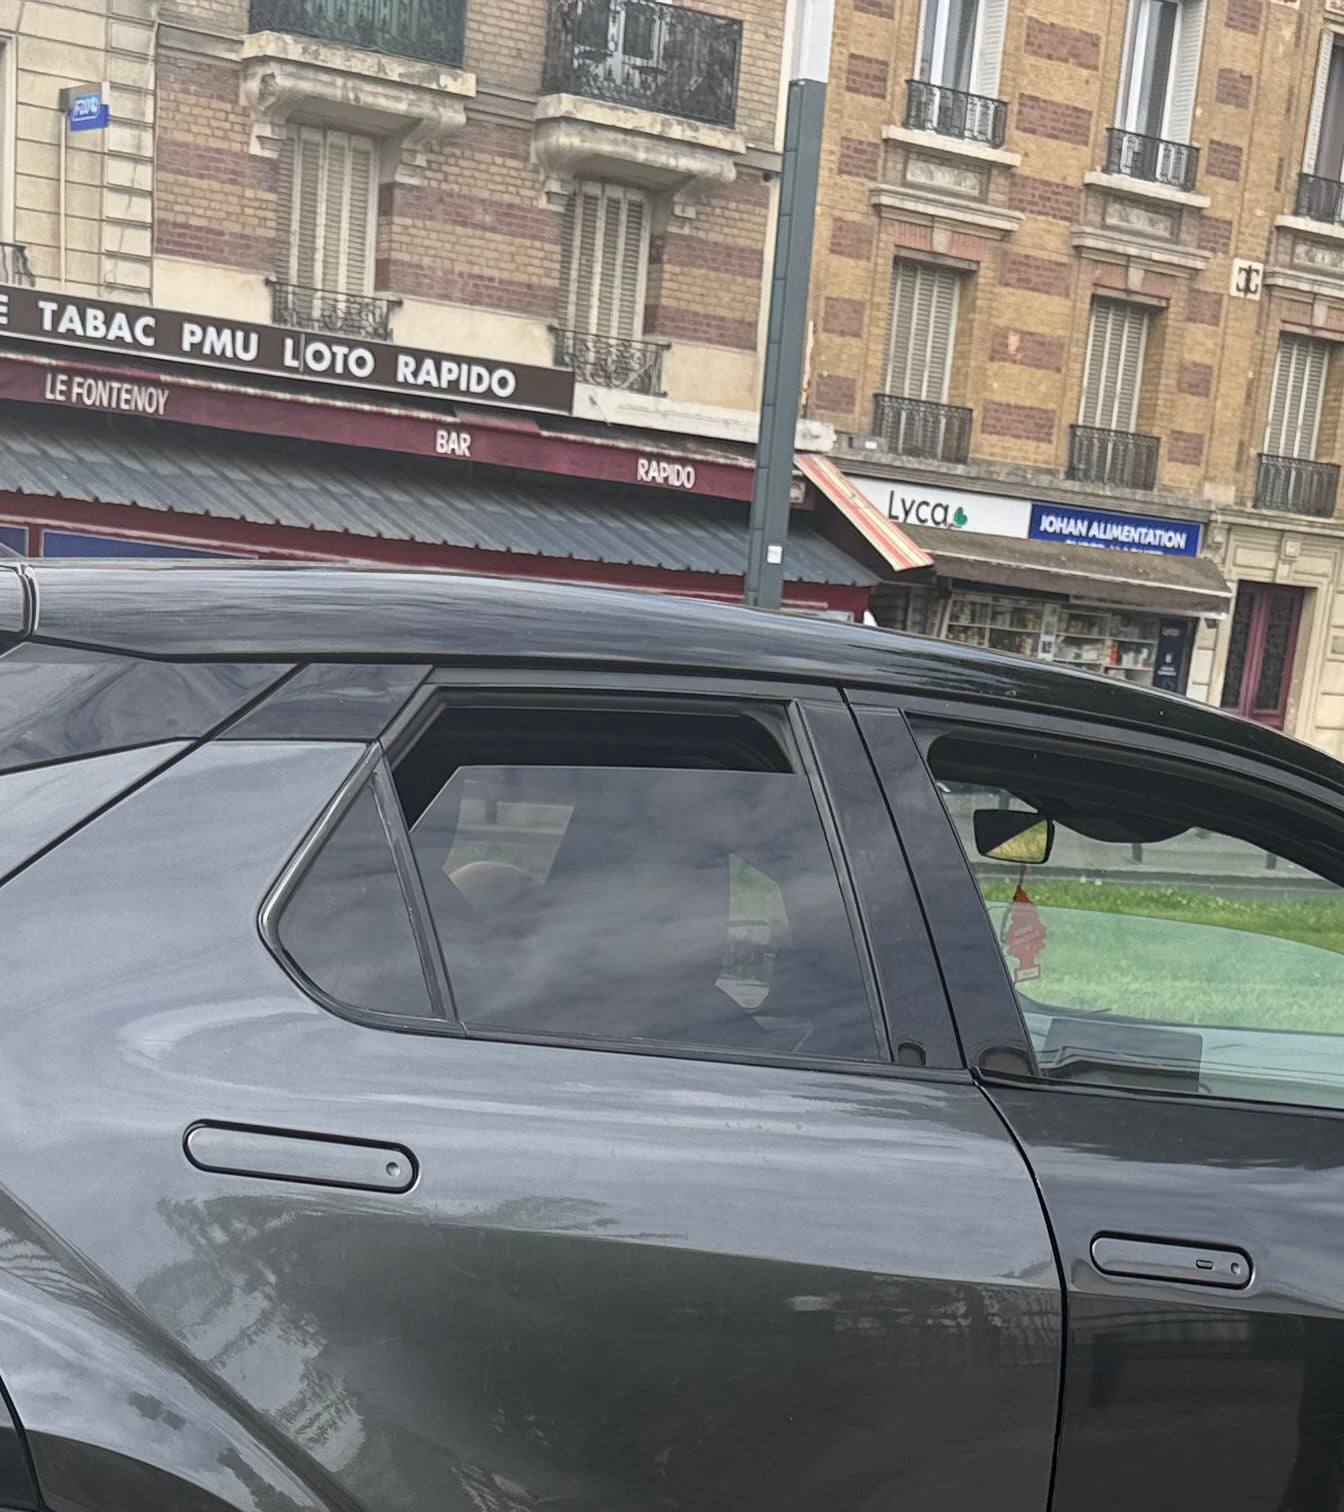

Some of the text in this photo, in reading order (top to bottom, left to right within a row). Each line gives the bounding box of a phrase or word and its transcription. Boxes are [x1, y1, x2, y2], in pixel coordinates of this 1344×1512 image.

[38, 300, 157, 347] TABAC
[181, 322, 260, 361] PMU
[283, 337, 376, 379] LOTO
[396, 354, 517, 398] RAPIDO
[45, 373, 170, 416] LE FONTENOY
[435, 429, 472, 458] BAR
[637, 457, 696, 489] RAPIDO
[888, 490, 949, 527] Lyca
[1039, 513, 1088, 538] JOHAN
[1089, 520, 1187, 550] ALIMENTATION
